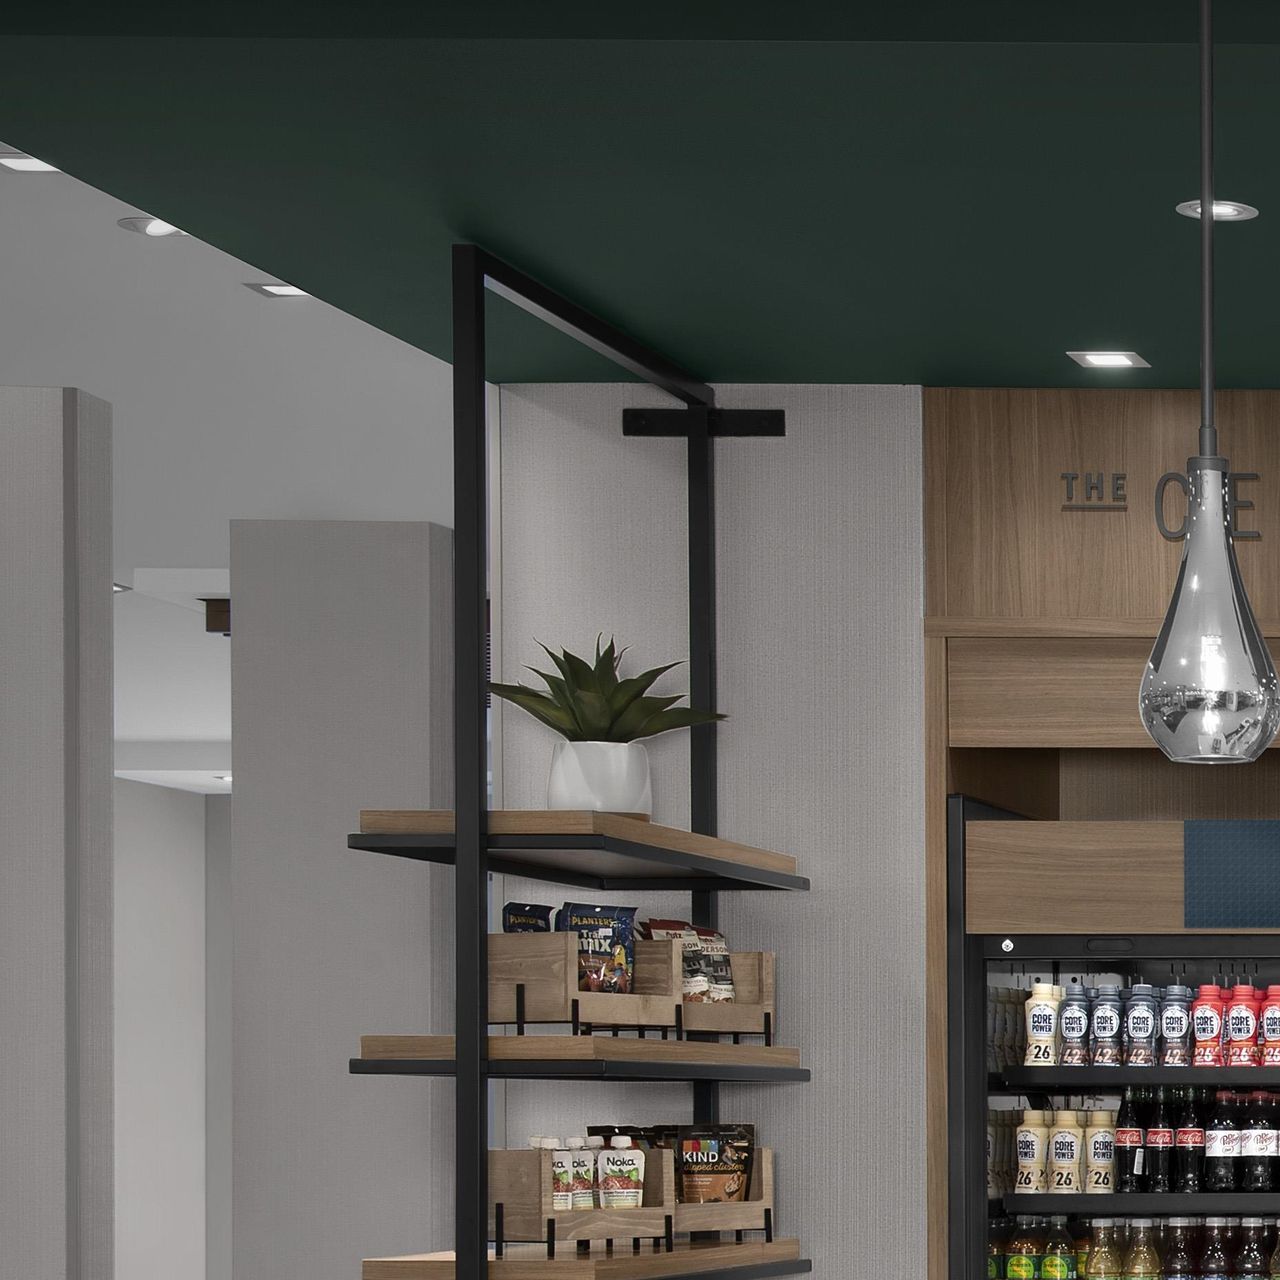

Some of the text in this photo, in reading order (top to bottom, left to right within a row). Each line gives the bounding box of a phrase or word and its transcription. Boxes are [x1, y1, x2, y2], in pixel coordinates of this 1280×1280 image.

[1062, 473, 1128, 500] THE
[1032, 1014, 1052, 1024] CORE
[1064, 1016, 1082, 1025] CORE
[1096, 1016, 1113, 1025] CORE
[1132, 1016, 1149, 1025] CORE
[1165, 1016, 1183, 1025] CORE
[1196, 1016, 1214, 1026] CORE
[1231, 1016, 1250, 1026] CORE
[1032, 1024, 1052, 1032] POWER
[1196, 1027, 1214, 1035] POWER
[1018, 1140, 1035, 1150] CORE
[1055, 1141, 1074, 1151] CORE
[1094, 1141, 1113, 1151] CORE
[683, 1152, 718, 1163] KIND
[1019, 1151, 1035, 1159] POWER
[1055, 1152, 1074, 1160] POWER
[606, 1158, 635, 1167] Noka
[1018, 1171, 1031, 1185] 26
[1056, 1172, 1072, 1186] 26
[1094, 1171, 1110, 1185] 26
